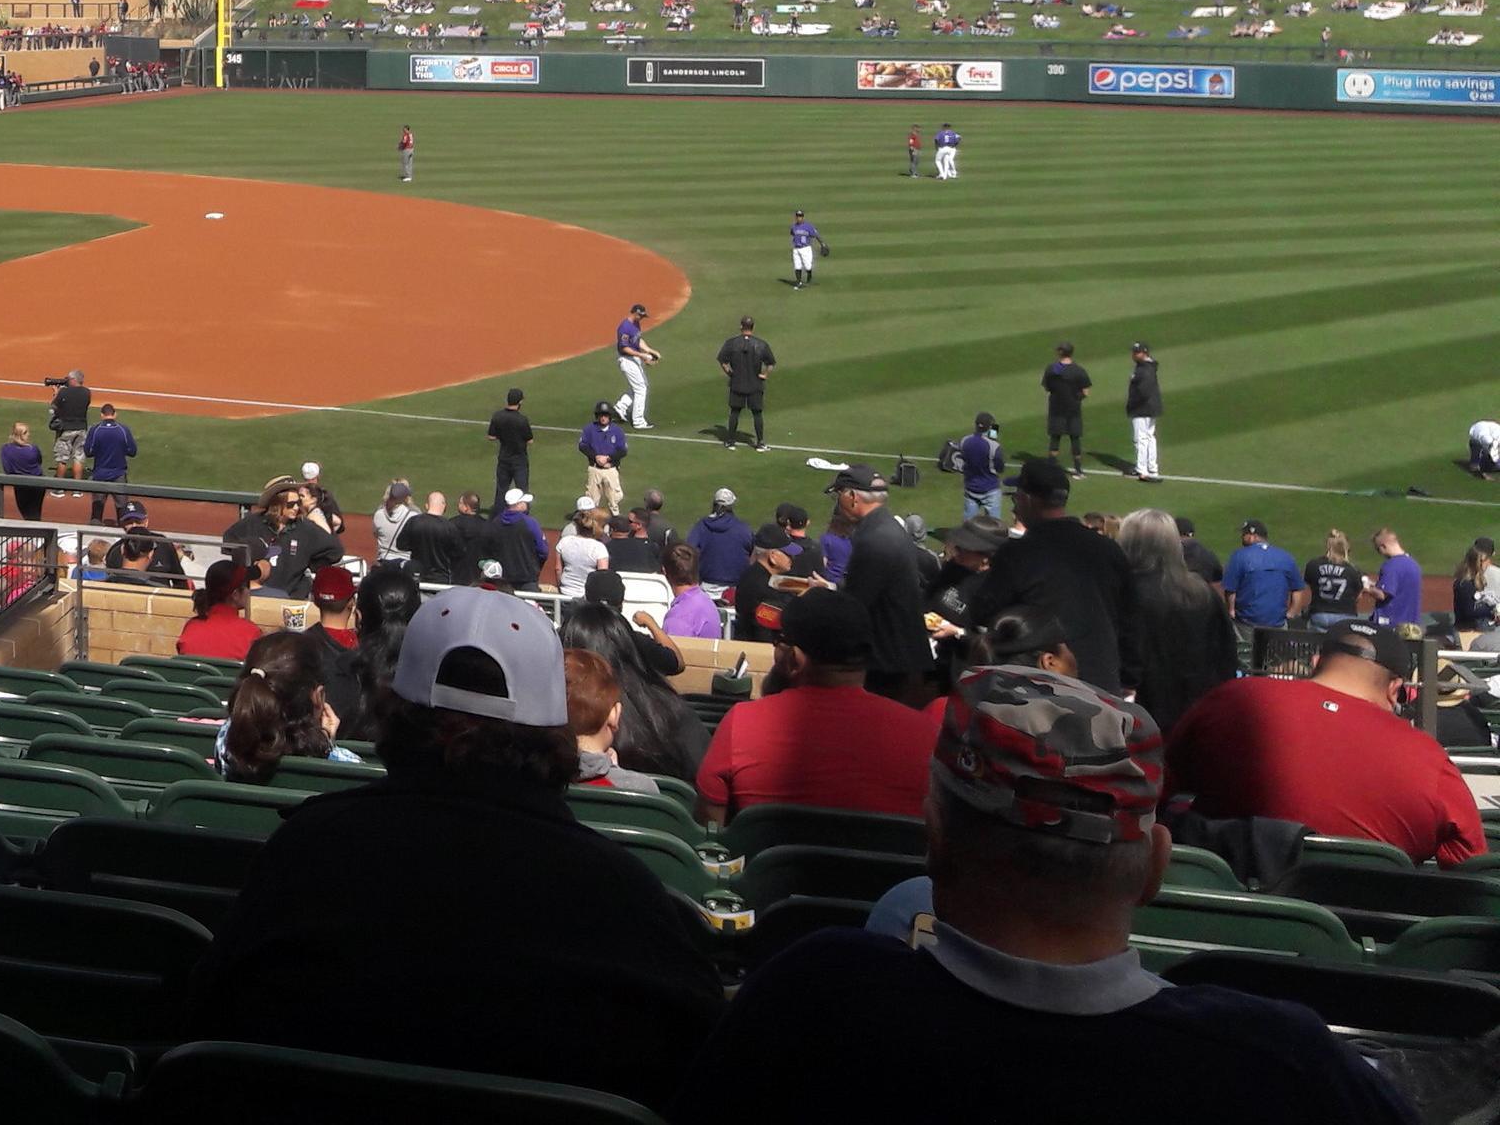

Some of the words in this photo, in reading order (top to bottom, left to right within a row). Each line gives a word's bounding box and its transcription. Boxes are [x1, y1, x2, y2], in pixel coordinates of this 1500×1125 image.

[226, 54, 243, 64] 345
[494, 65, 518, 73] CIRCLE
[1120, 69, 1194, 92] pepsi
[1384, 75, 1412, 88] Plug
[1415, 77, 1441, 88] into
[1444, 78, 1495, 91] savings
[1318, 577, 1347, 600] 27
